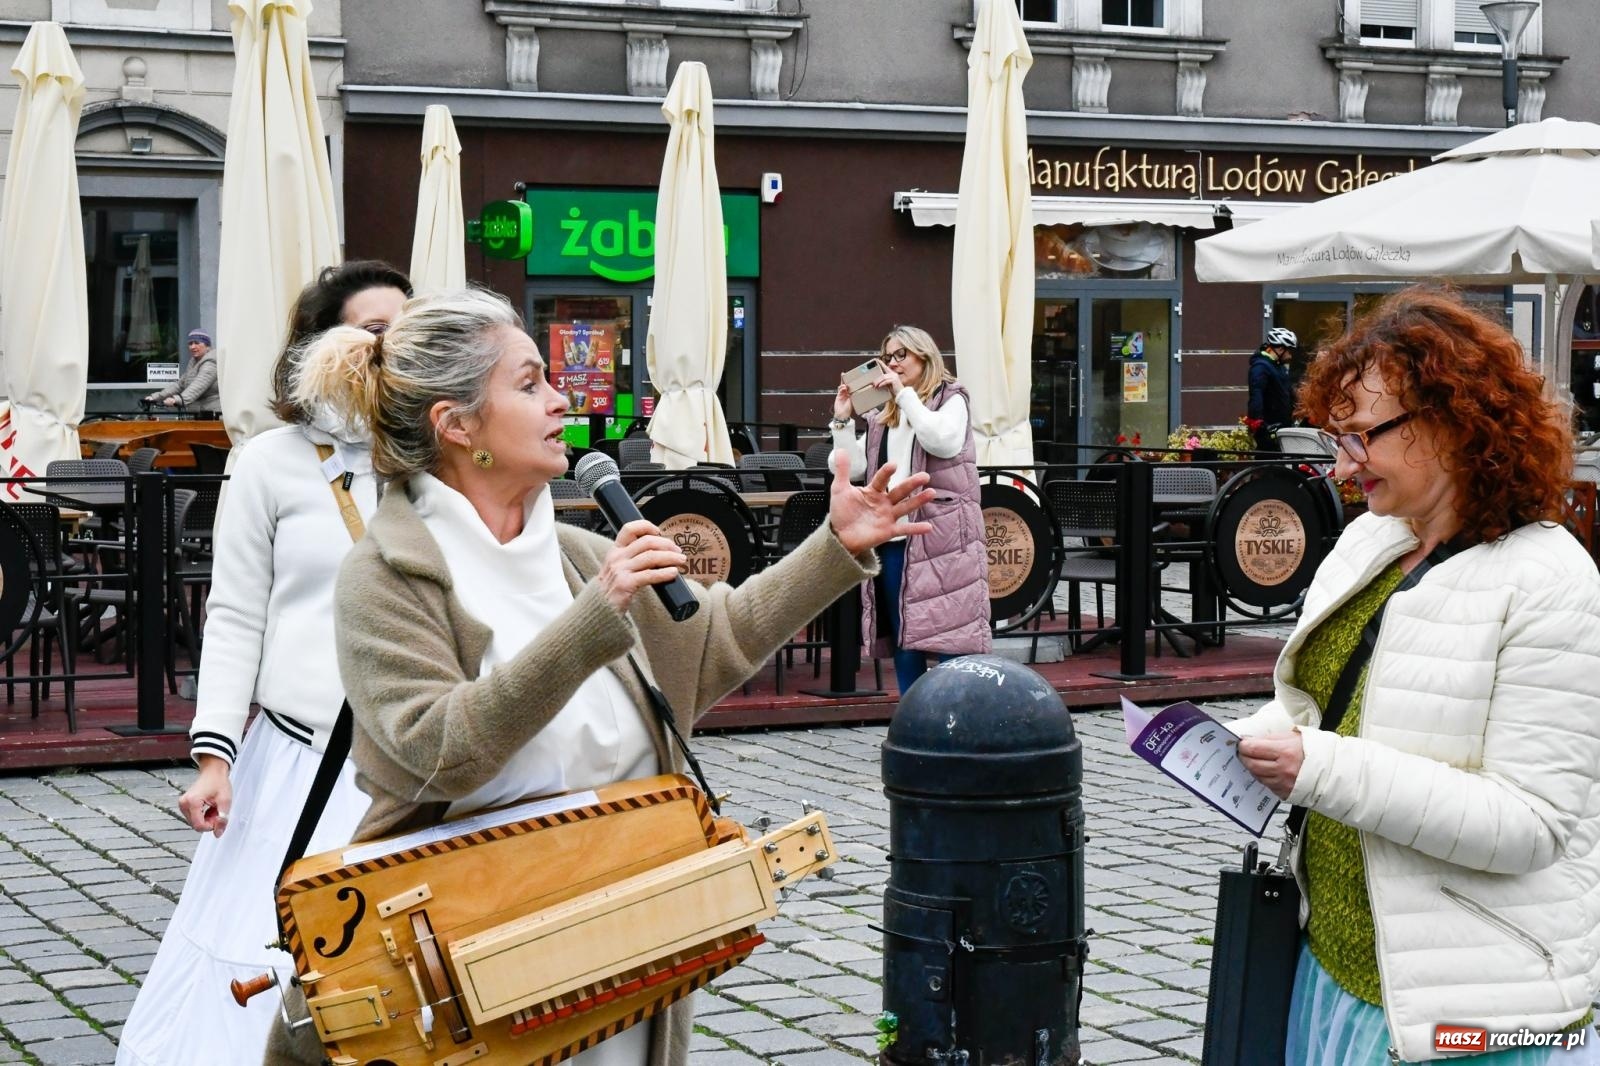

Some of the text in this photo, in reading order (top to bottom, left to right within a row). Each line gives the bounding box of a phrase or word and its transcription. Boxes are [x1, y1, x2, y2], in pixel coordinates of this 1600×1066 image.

[1206, 154, 1307, 197] Lodów
[1315, 154, 1415, 194] Gałe
[560, 206, 729, 257] żab
[1331, 244, 1363, 261] Lodów
[1244, 538, 1295, 556] TYSKIE
[986, 548, 1024, 566] SKIE
[678, 558, 718, 575] SKIE
[1145, 721, 1174, 751] OFF-ka
